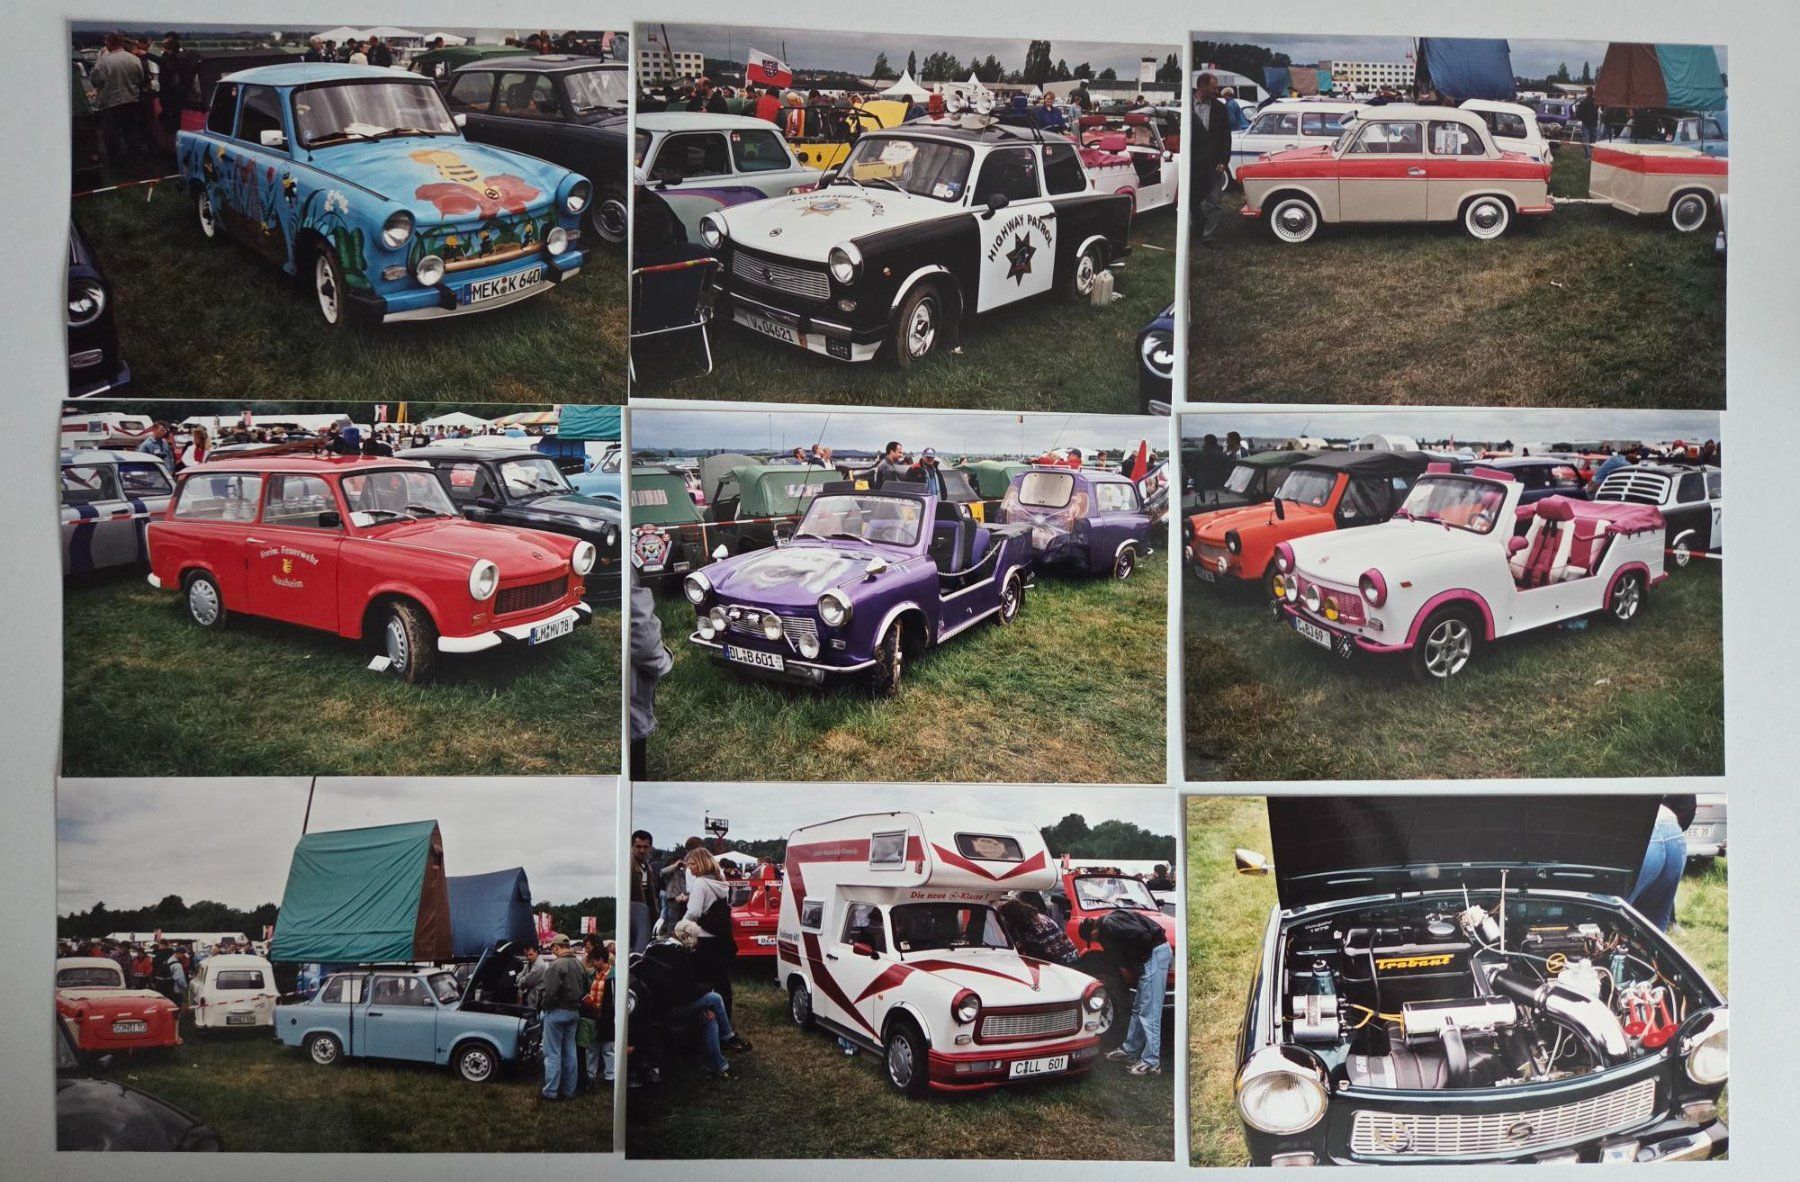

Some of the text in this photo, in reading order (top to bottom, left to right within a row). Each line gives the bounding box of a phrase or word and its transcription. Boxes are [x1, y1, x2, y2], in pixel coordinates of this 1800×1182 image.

[987, 214, 1053, 263] HIGHWAY PATROL
[472, 268, 541, 301] MEK K 640
[281, 545, 319, 566] Feuerwehr
[747, 650, 754, 663] B
[755, 652, 776, 668] 601
[910, 891, 926, 900] Die
[1015, 1057, 1064, 1075] C LL 601
